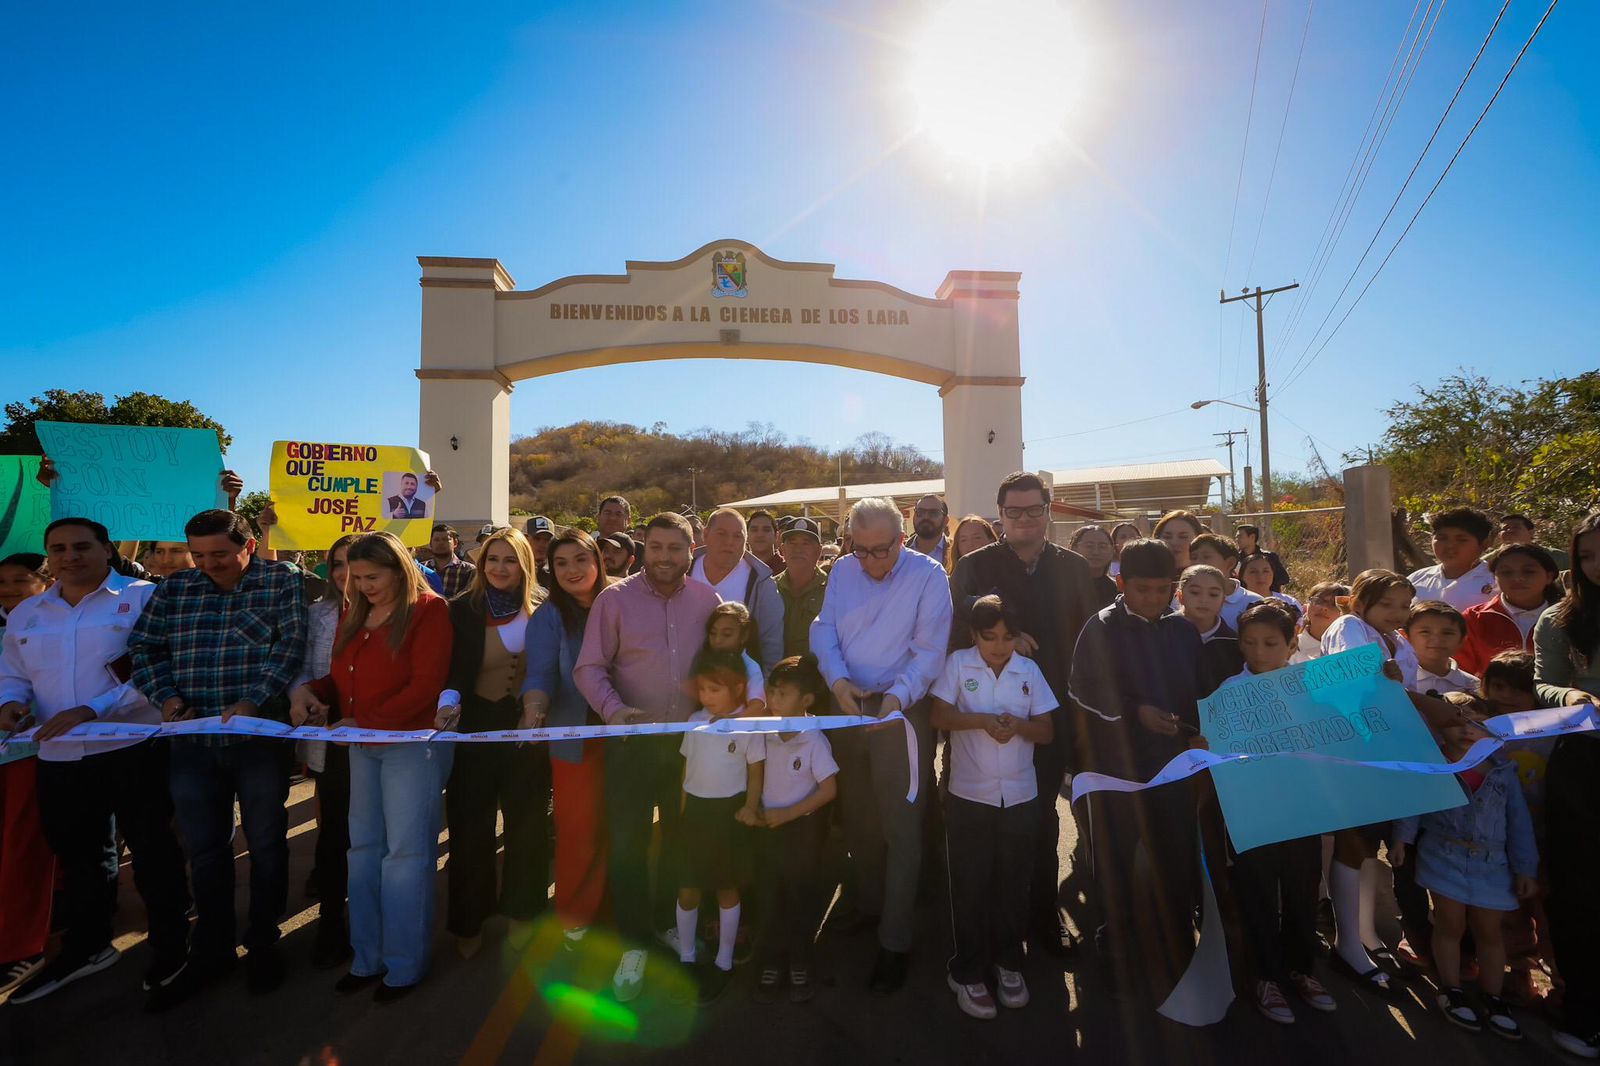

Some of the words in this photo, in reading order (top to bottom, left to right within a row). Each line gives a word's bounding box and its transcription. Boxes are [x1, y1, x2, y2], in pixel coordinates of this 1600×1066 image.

[550, 303, 667, 321] BIENVENIDOS
[672, 305, 684, 322] A
[690, 306, 711, 322] LA
[719, 306, 793, 324] CIENEGA
[801, 308, 821, 324] DE
[829, 308, 860, 325] LOS
[867, 309, 910, 325] LARA
[39, 424, 181, 467] ESTOY
[286, 442, 378, 462] GOBIERNO
[286, 460, 325, 476] QUE
[55, 461, 152, 498] CON
[307, 495, 359, 515] JOSÉ
[341, 516, 377, 533] PAZ
[1279, 651, 1383, 698] GRACIAS
[1229, 706, 1391, 764] GOBERNADOR
